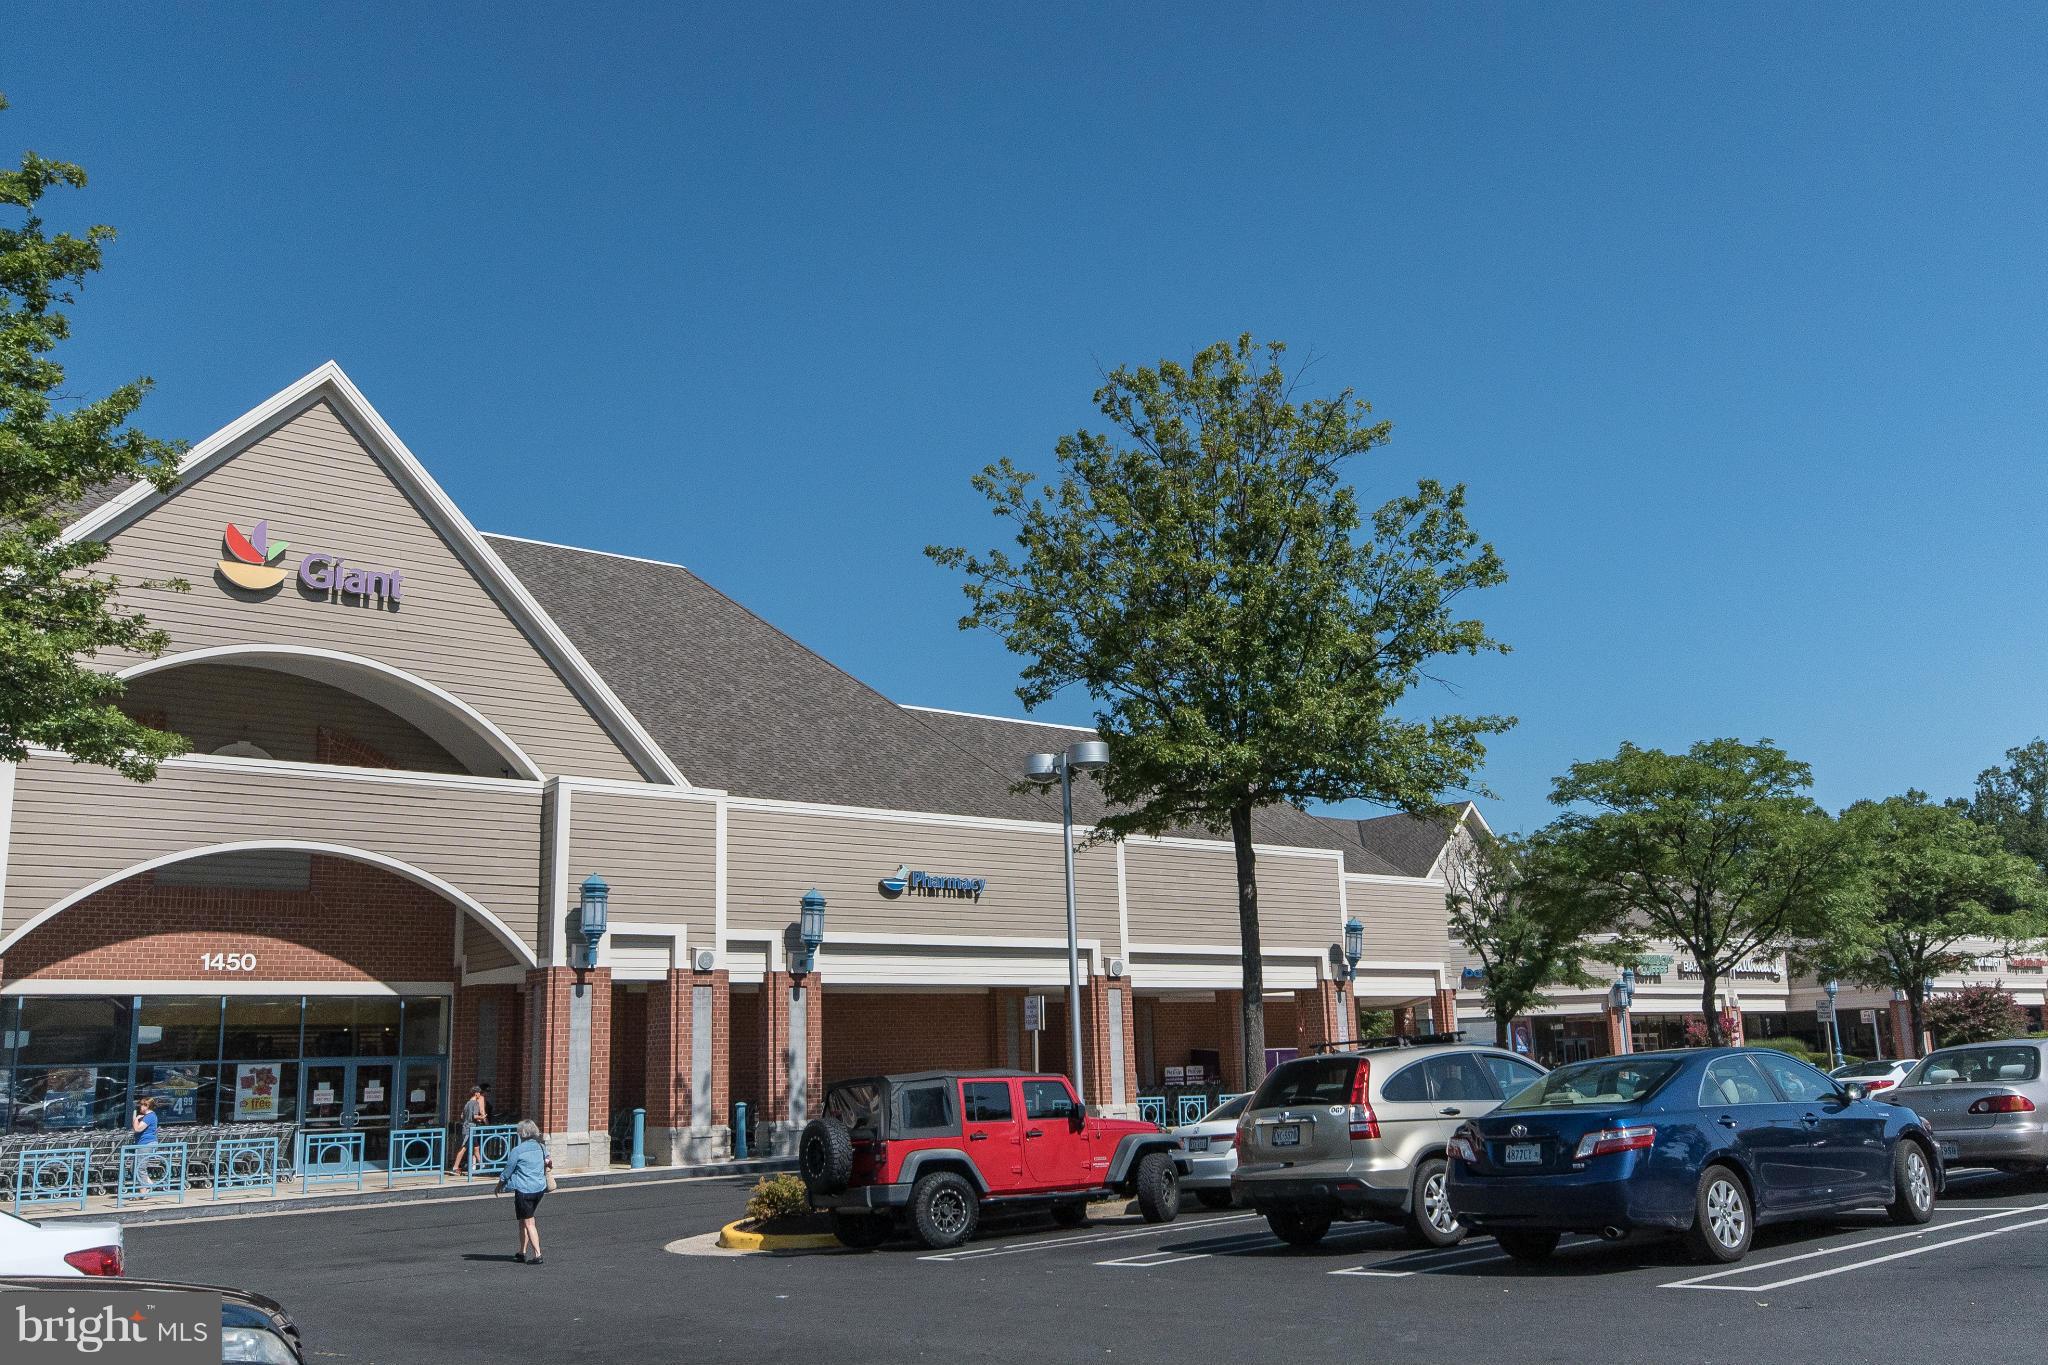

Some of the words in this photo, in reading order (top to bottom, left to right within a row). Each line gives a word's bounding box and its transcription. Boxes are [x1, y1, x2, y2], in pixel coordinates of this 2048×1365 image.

[300, 553, 404, 600] Giant
[911, 871, 986, 896] Pharmacy
[201, 953, 257, 971] 1450
